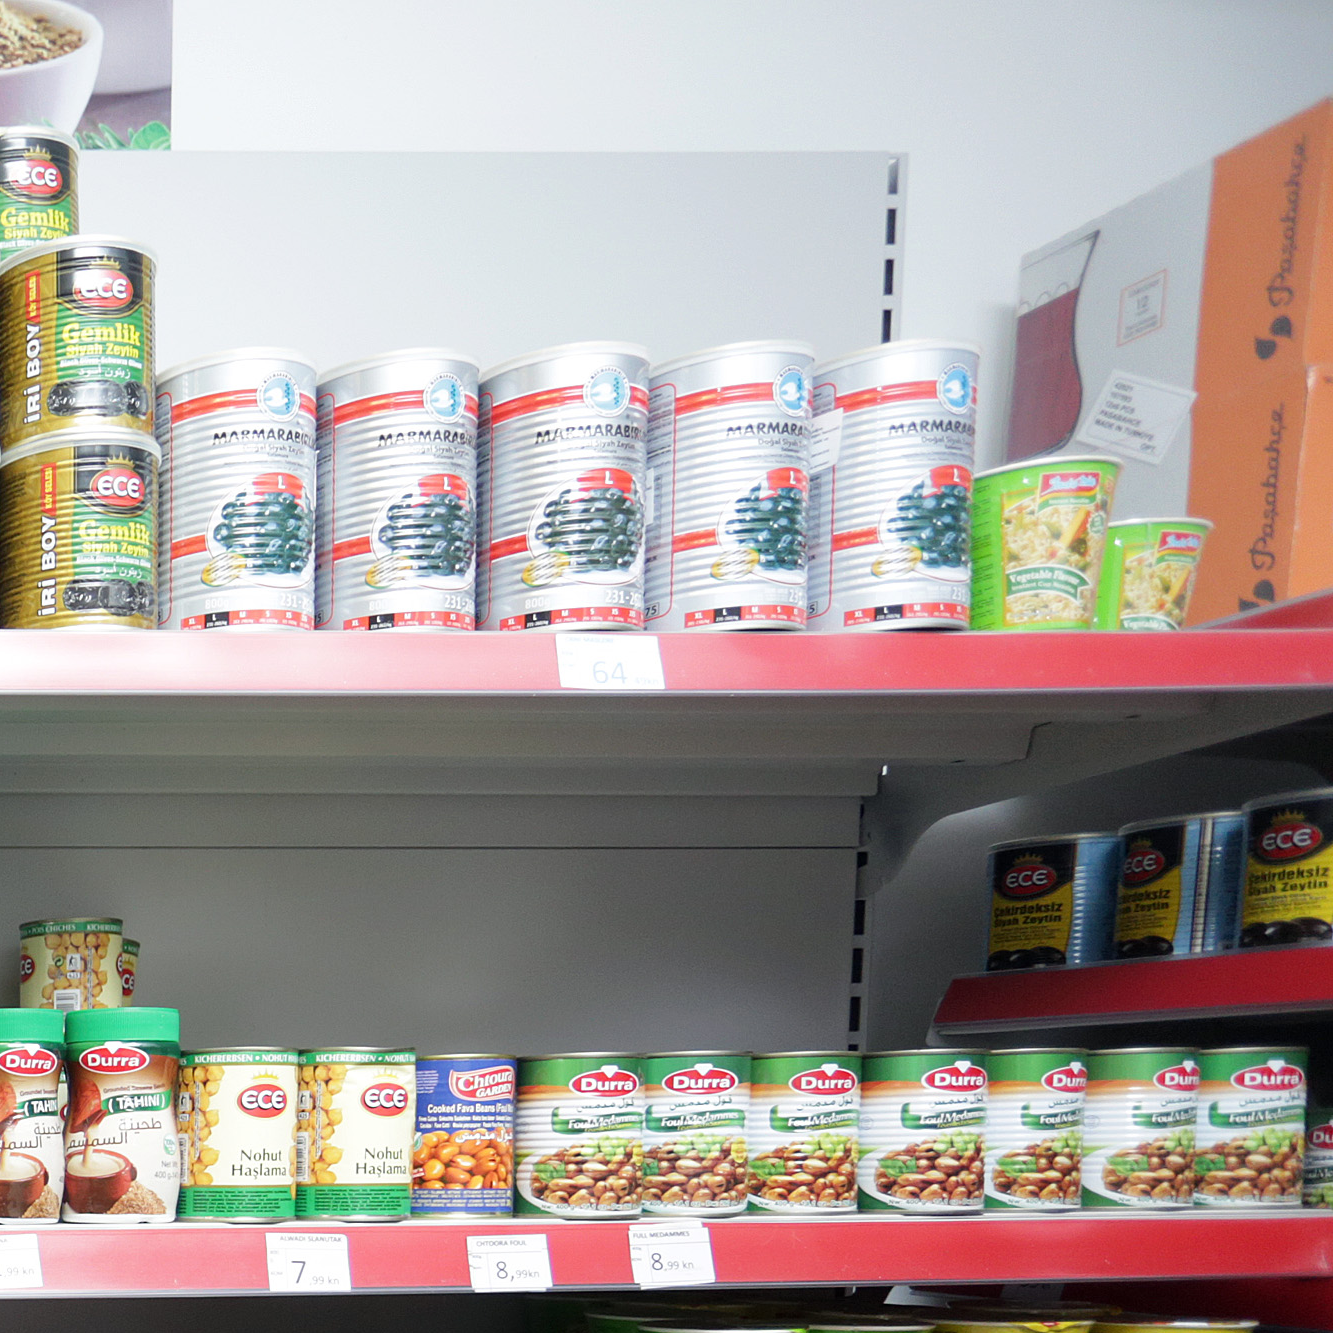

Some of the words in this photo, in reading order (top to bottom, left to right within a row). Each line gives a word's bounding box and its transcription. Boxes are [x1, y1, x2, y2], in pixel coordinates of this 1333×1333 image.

[1262, 828, 1311, 850] ECE
[87, 1050, 141, 1068] Durra
[673, 1075, 731, 1090] Durra
[1244, 1072, 1300, 1087] Durra
[241, 1092, 286, 1109] ECE
[241, 1149, 282, 1163] Nohut
[231, 1164, 287, 1178] Haşlama
[682, 1261, 694, 1270] kn
